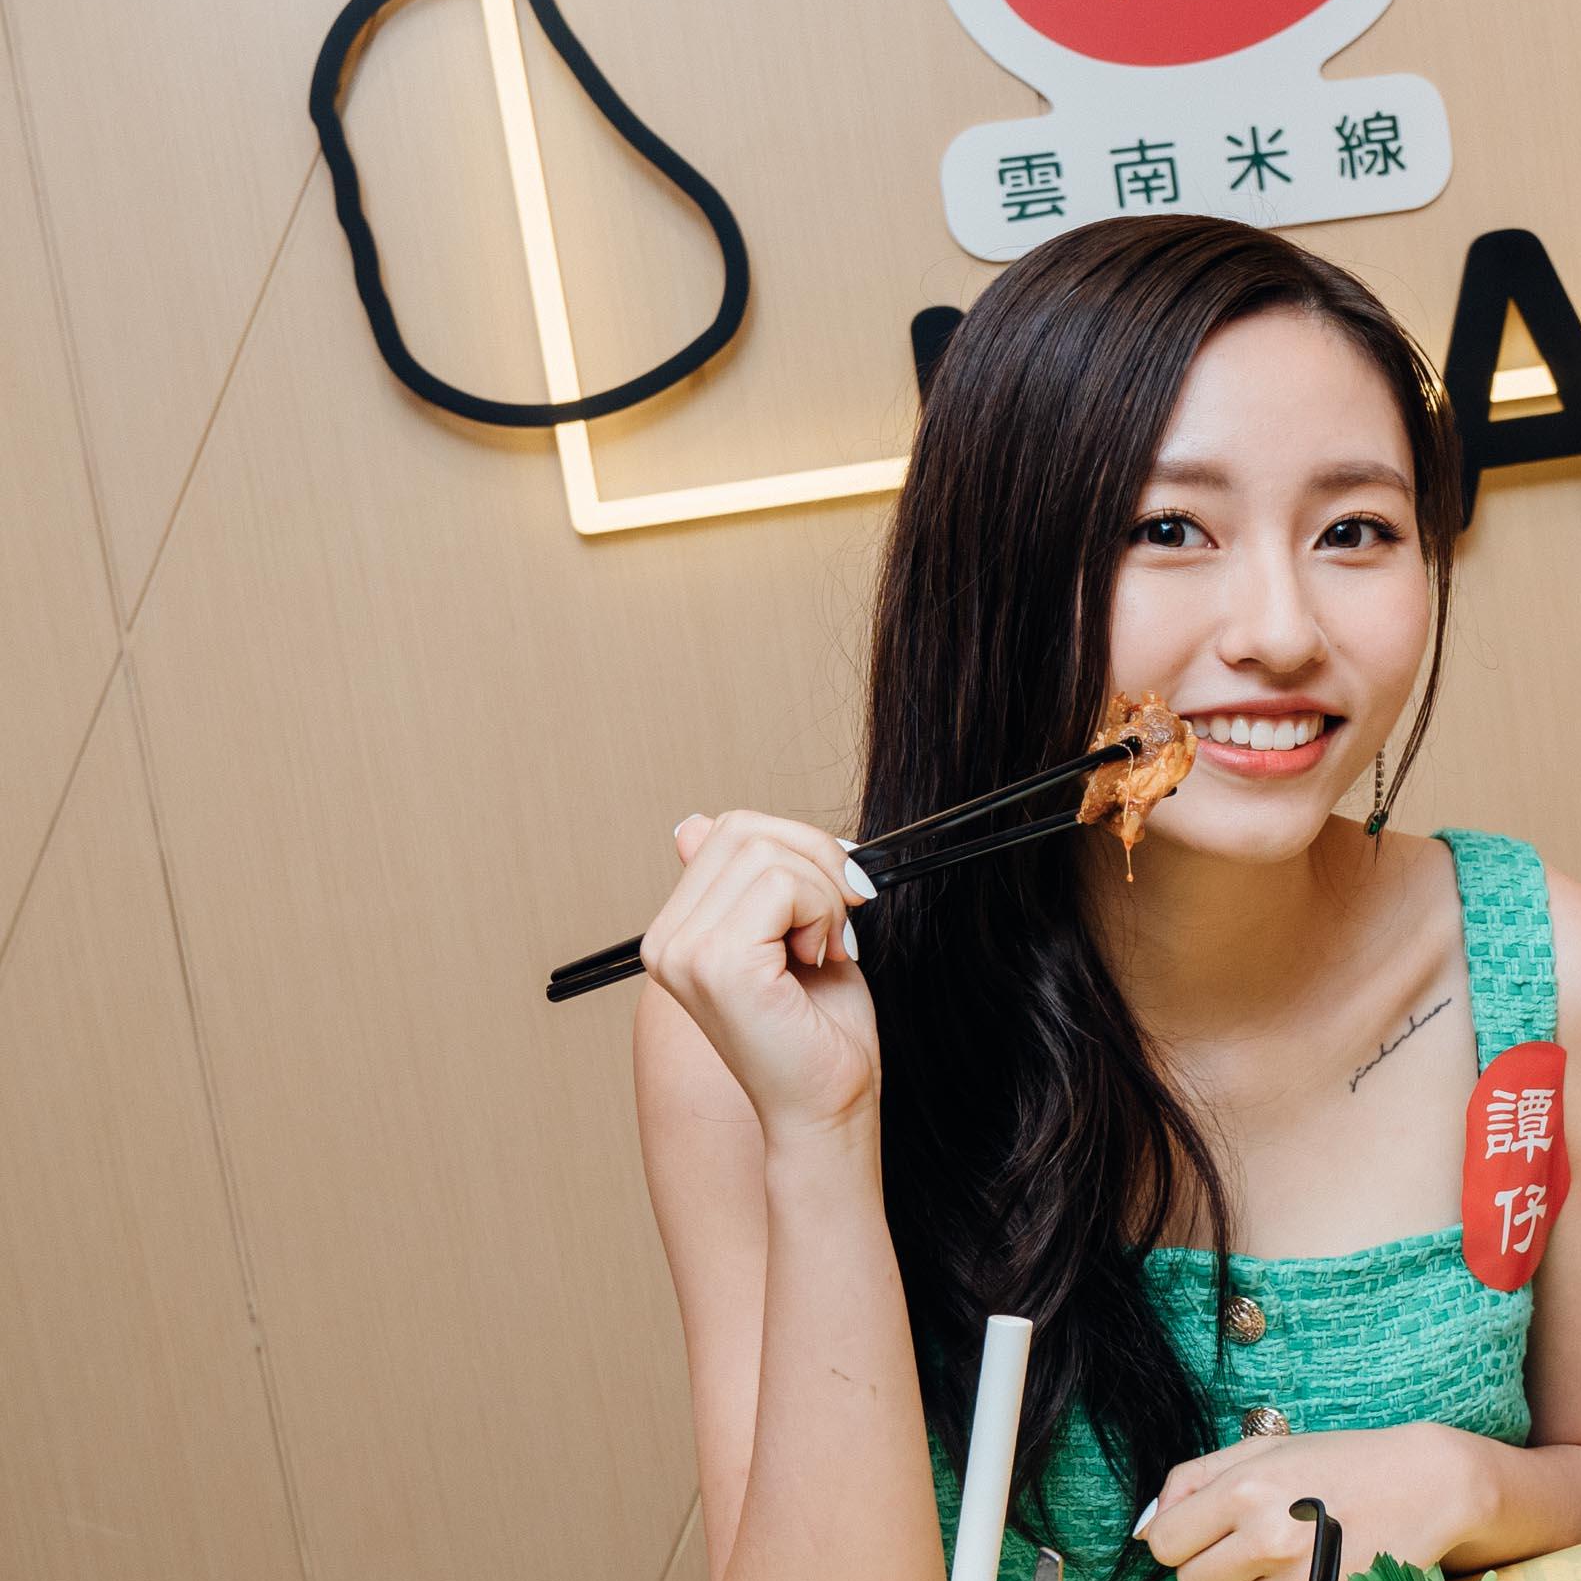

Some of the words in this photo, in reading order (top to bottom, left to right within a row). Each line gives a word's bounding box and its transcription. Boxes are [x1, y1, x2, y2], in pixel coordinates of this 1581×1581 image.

[996, 109, 1407, 223] 雲南米線
[1484, 1087, 1556, 1256] 譚仔
